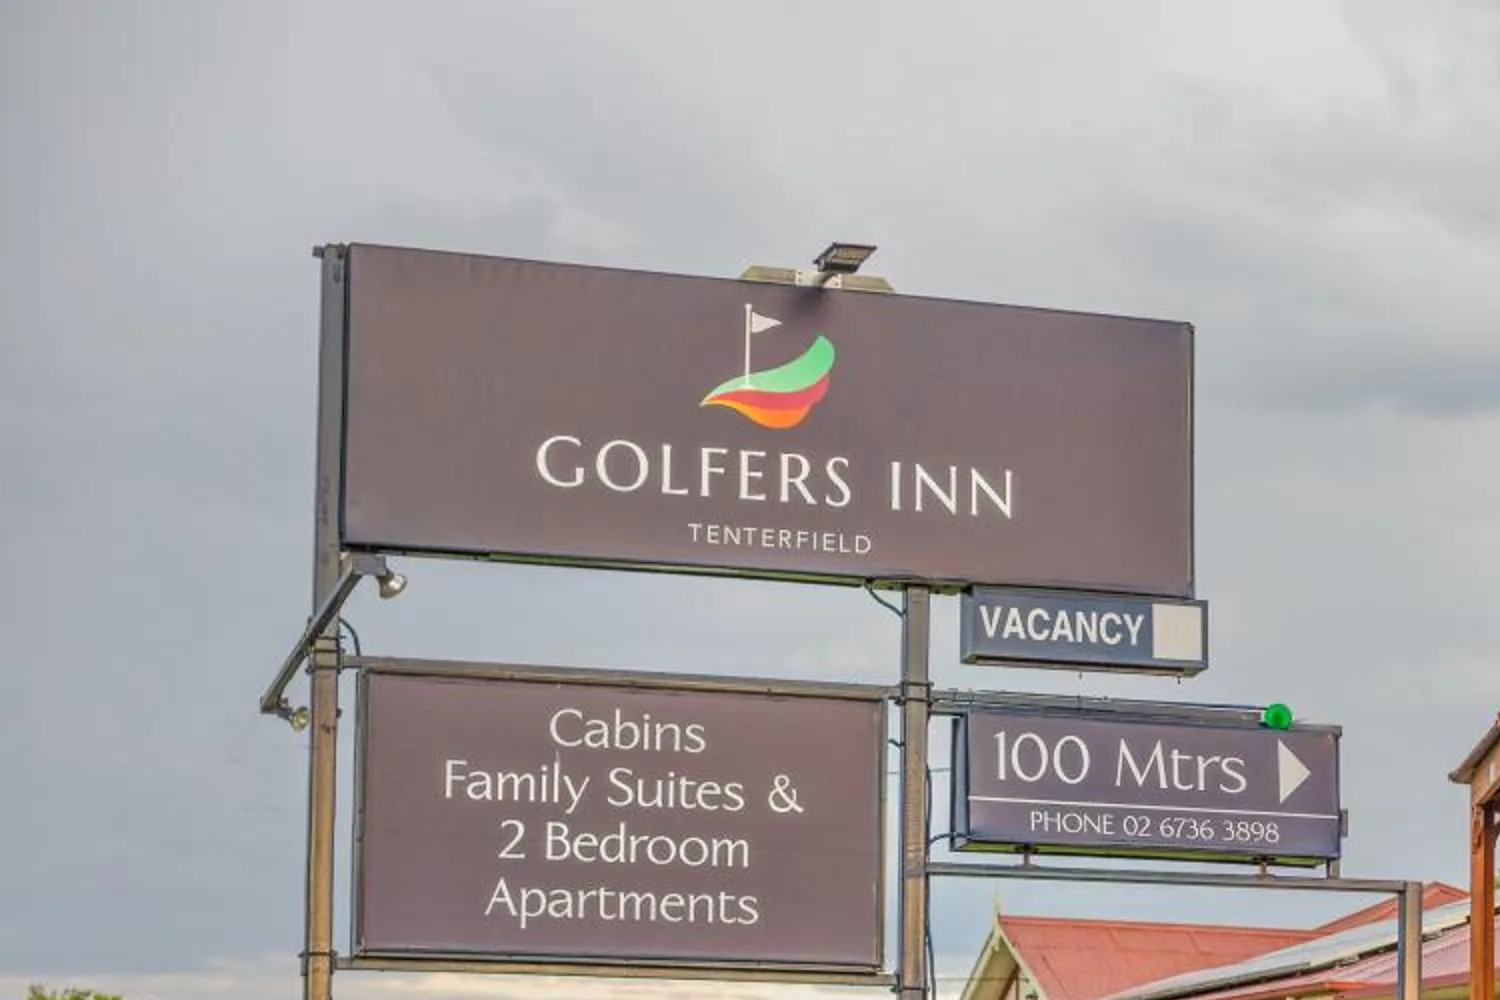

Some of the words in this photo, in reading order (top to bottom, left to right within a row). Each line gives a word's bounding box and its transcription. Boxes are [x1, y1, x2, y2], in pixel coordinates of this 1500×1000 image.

[535, 434, 852, 508] GOLFERS
[890, 461, 1017, 520] INN
[687, 523, 872, 555] TENTERFIELD
[979, 605, 1145, 646] VACANCY
[549, 708, 707, 753] Cabins
[444, 757, 590, 814] Family
[607, 767, 745, 812] Suites
[767, 774, 804, 814] &
[994, 730, 1090, 786] 100
[1115, 737, 1248, 795] Mtrs
[498, 819, 526, 860] 2
[546, 821, 750, 868] Bedroom
[1030, 811, 1114, 836] PHONE
[1123, 815, 1152, 838] 02
[1160, 817, 1214, 841] 6736
[1223, 819, 1280, 844] 3898
[484, 876, 760, 929] Apartments
